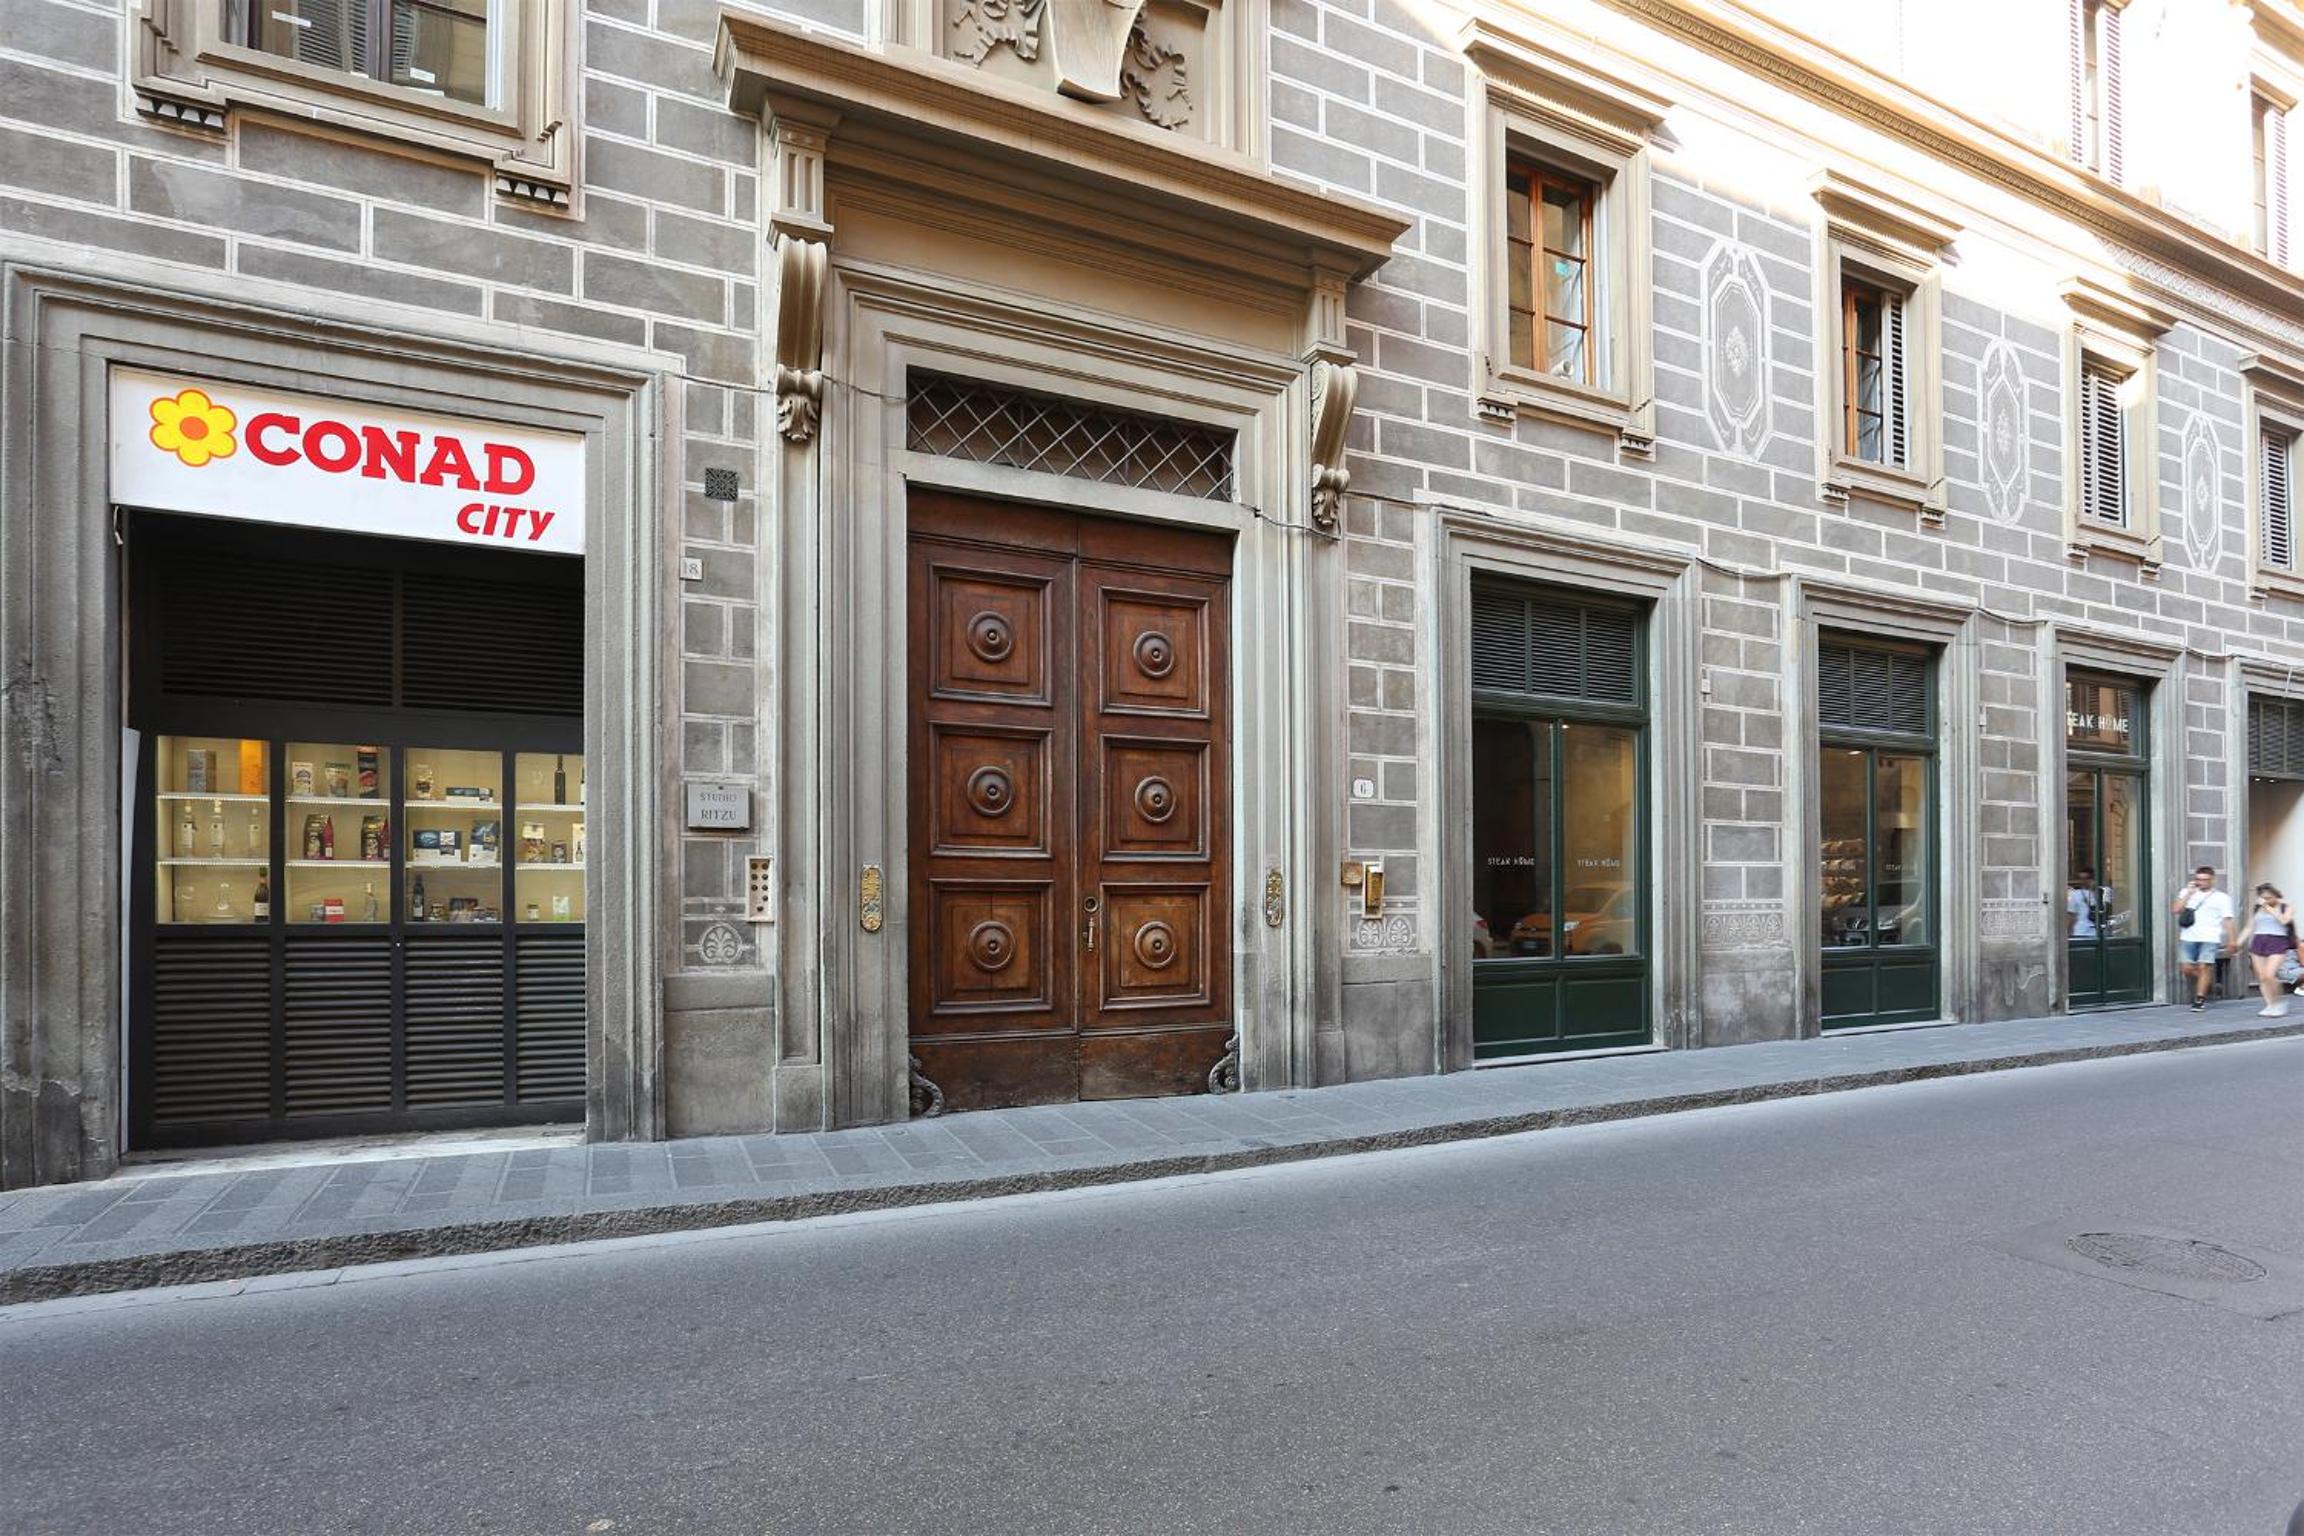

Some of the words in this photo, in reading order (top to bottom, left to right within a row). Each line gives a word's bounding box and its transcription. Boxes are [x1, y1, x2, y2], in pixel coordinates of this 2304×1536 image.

[244, 412, 536, 496] CONAD
[456, 502, 555, 541] CITY
[2066, 711, 2095, 729] TEAK
